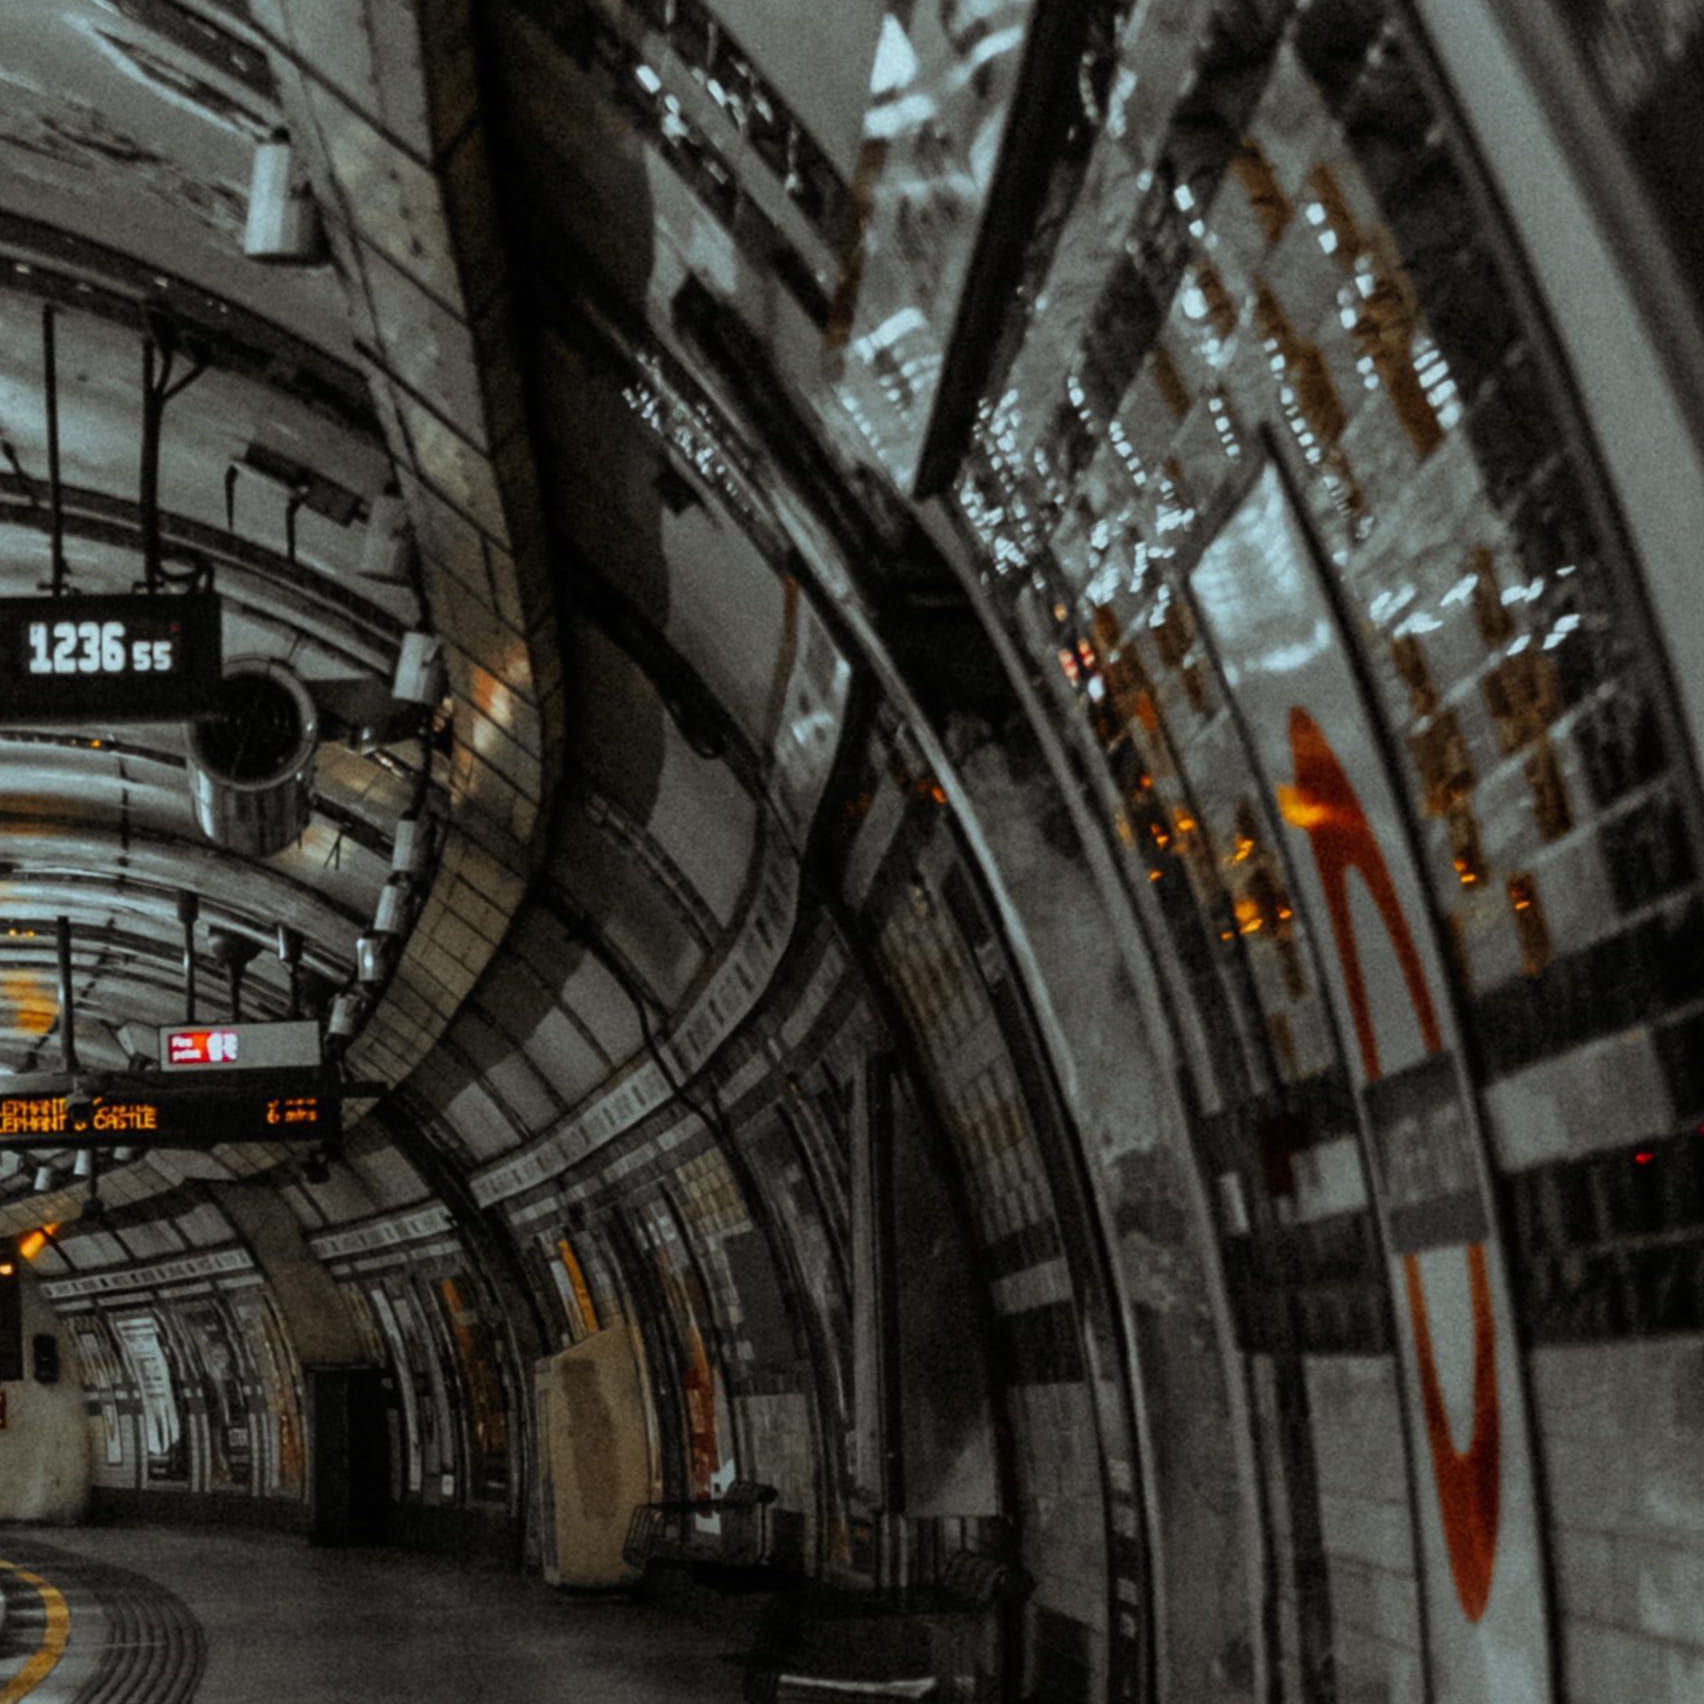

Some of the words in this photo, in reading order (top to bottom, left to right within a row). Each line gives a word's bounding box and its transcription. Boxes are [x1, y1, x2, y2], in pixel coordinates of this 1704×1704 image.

[29, 621, 126, 673] 1236
[132, 641, 172, 672] 55
[93, 1112, 157, 1130] CASTLE
